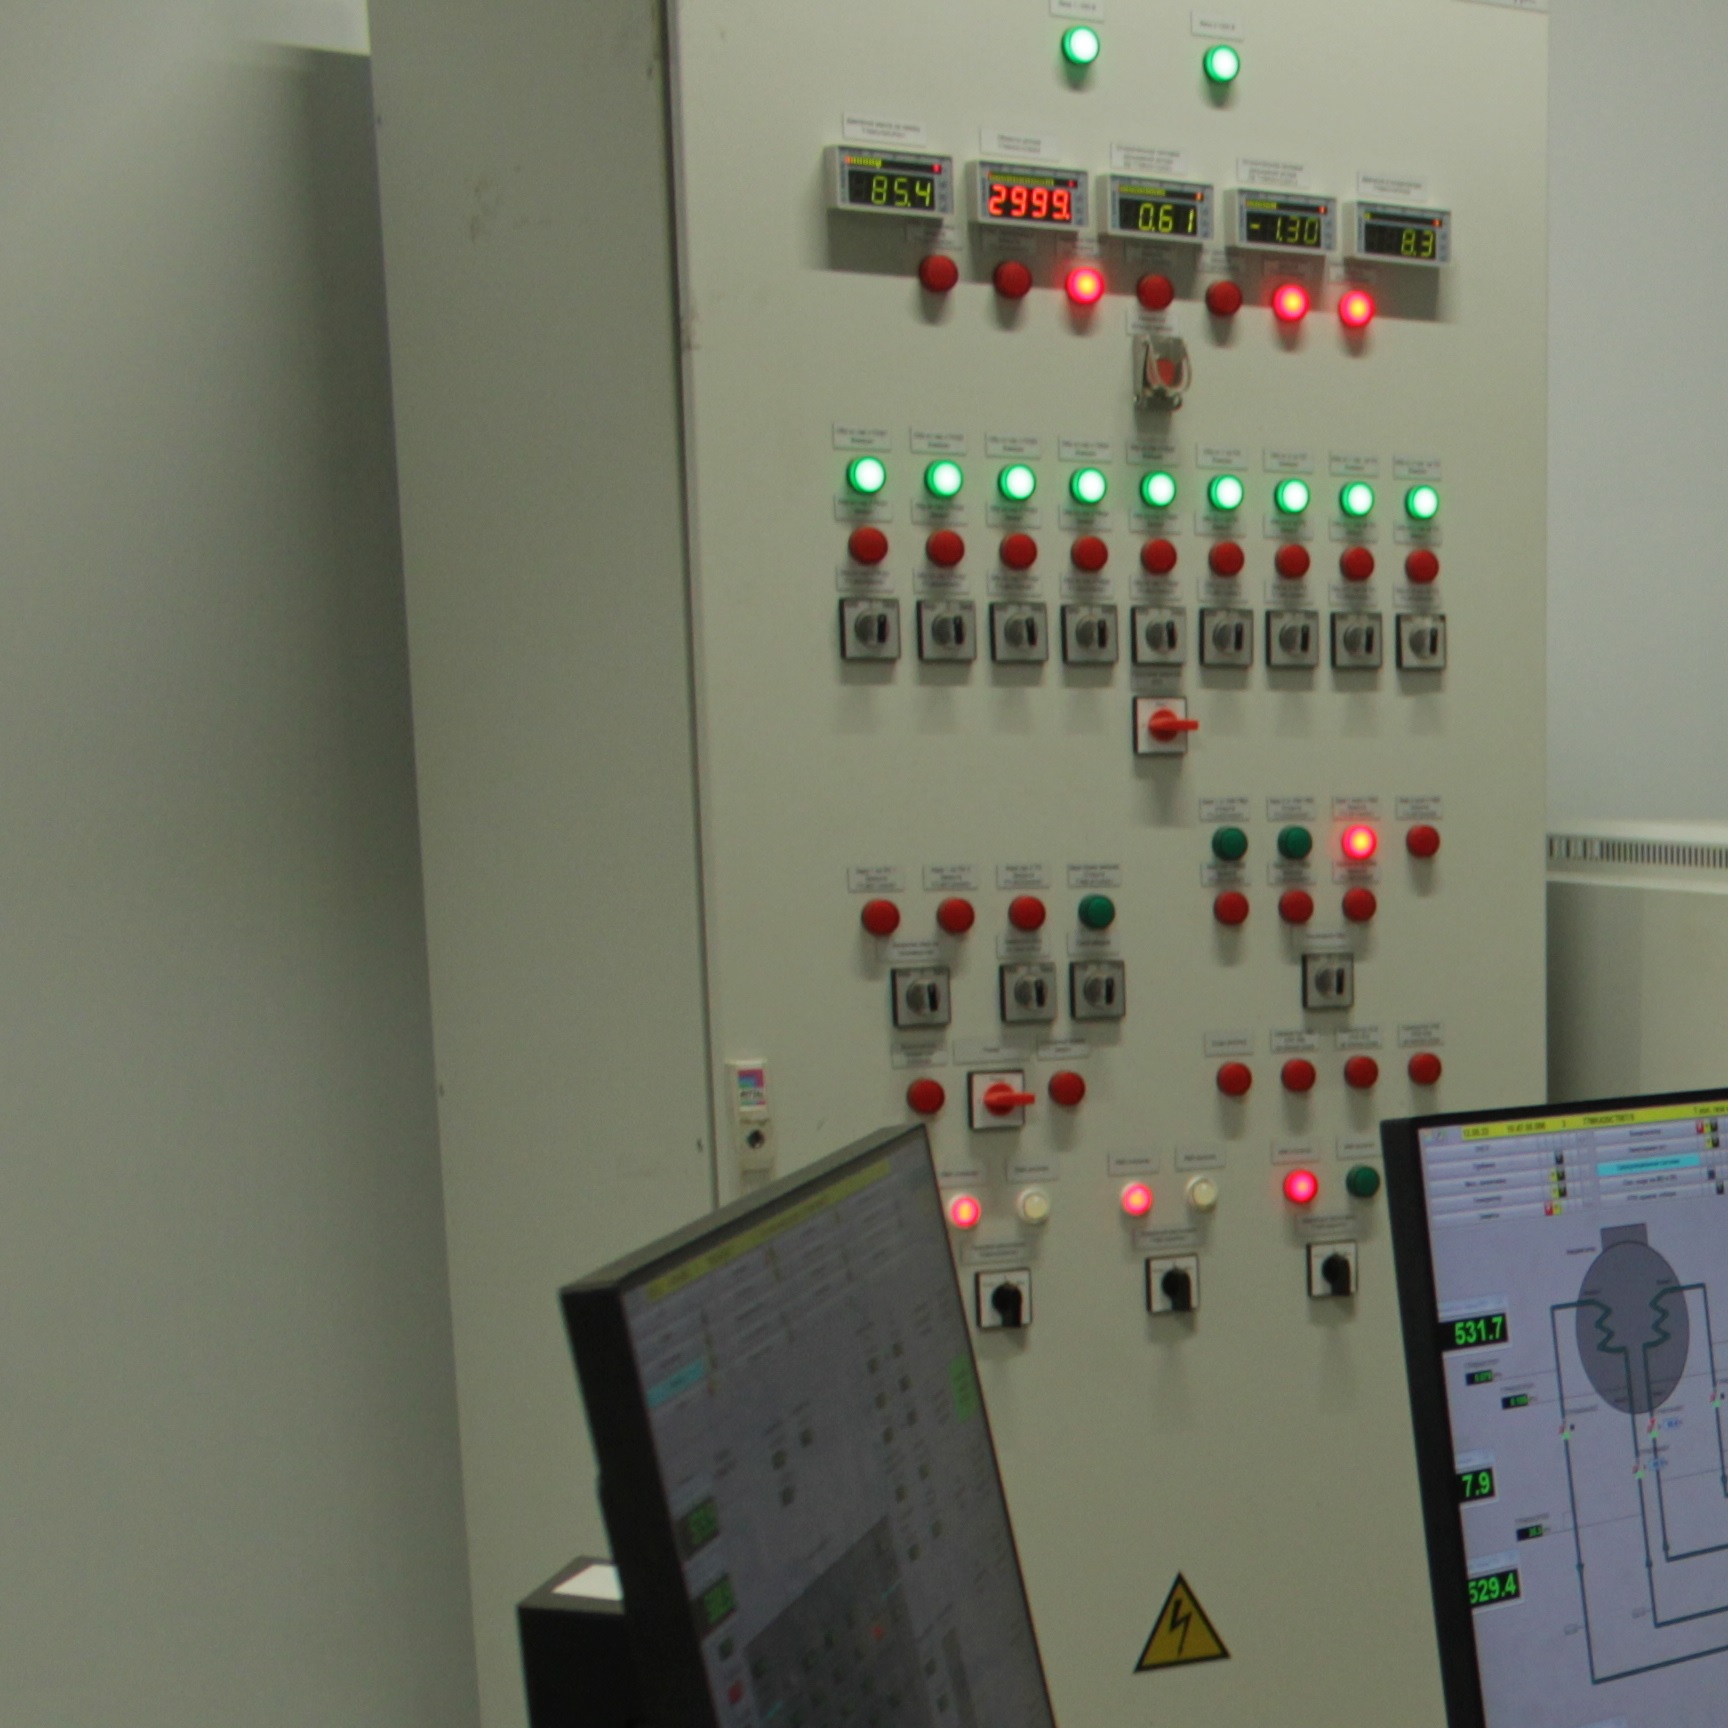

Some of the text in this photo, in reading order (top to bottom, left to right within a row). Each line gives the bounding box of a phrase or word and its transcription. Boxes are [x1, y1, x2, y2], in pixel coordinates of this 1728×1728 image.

[871, 175, 932, 208] 85.4
[1138, 202, 1195, 233] 0.61
[1400, 228, 1435, 257] 8.3
[1454, 1315, 1503, 1346] 531.7
[1461, 1471, 1491, 1498] 7.9
[1467, 1572, 1517, 1605] 529.4
